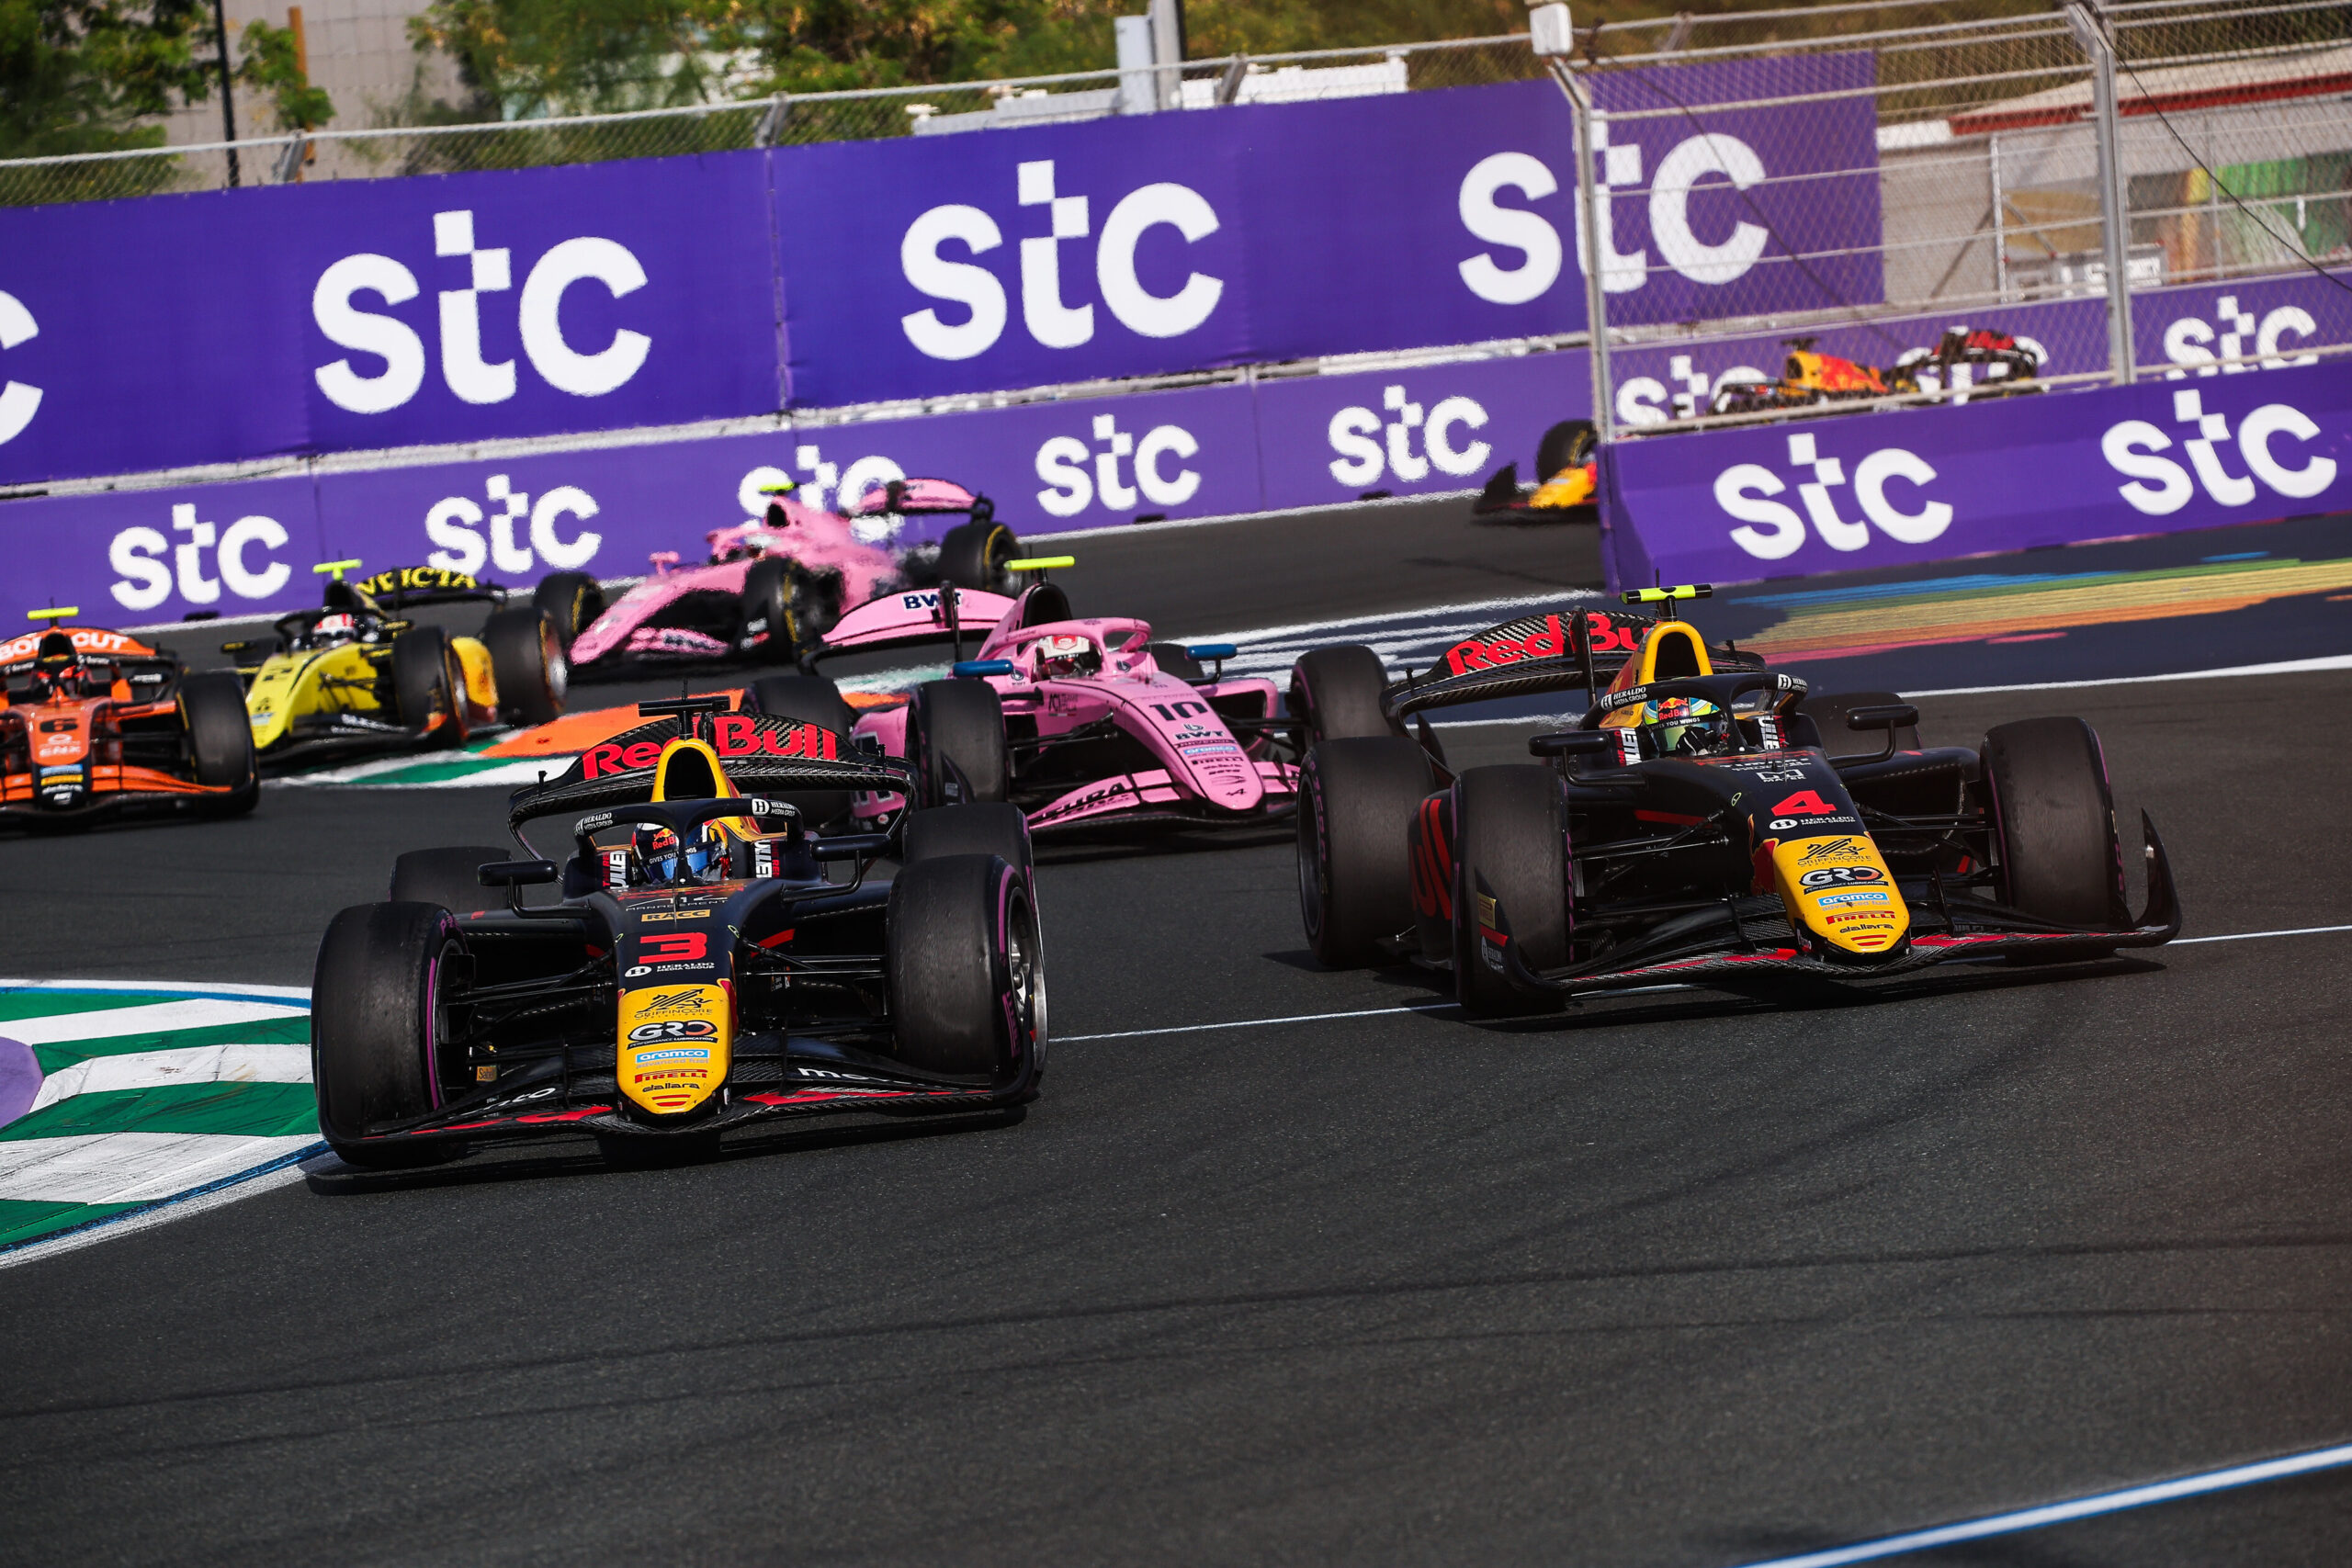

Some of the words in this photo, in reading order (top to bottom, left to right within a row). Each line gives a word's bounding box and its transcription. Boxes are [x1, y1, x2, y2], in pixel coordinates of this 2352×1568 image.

[1458, 108, 1770, 305] stc
[901, 160, 1225, 360] stc
[312, 209, 652, 413] stc
[2164, 295, 2320, 381] stc
[1329, 385, 1492, 486] stc
[2101, 389, 2337, 515] stc
[1035, 413, 1202, 516] stc
[1713, 433, 1953, 559] stc
[425, 474, 603, 573] stc
[109, 503, 291, 610] stc
[1446, 615, 1565, 676] Red
[1613, 687, 1646, 700] HERALDO
[1614, 697, 1629, 706] MEDIA
[1629, 693, 1647, 702] GROUP
[1148, 701, 1208, 721] 10
[1658, 712, 1673, 721] Red
[1673, 708, 1690, 717] Bull
[40, 718, 79, 733] 6
[1679, 716, 1701, 725] WINGS
[714, 716, 837, 761] Bull
[1175, 730, 1224, 740] BWT
[1770, 790, 1837, 816] 4
[583, 812, 613, 824] HERALDO
[652, 839, 668, 851] Red
[649, 855, 663, 864] GIVES
[663, 852, 676, 861] YOU
[1802, 866, 1881, 886] GRO
[1806, 883, 1847, 892] PERFORMANCE
[1822, 893, 1883, 905] aramco
[646, 910, 707, 920] RACC
[1826, 910, 1896, 925] PIRELLI
[1839, 924, 1894, 933] dallara
[639, 931, 707, 964] 3
[657, 962, 715, 970] HERALDO
[630, 1021, 714, 1041] GRO
[639, 1050, 706, 1061] aramco
[636, 1058, 686, 1069] advanced
[634, 1068, 708, 1084] PIRELLI
[642, 1082, 701, 1092] dallara
